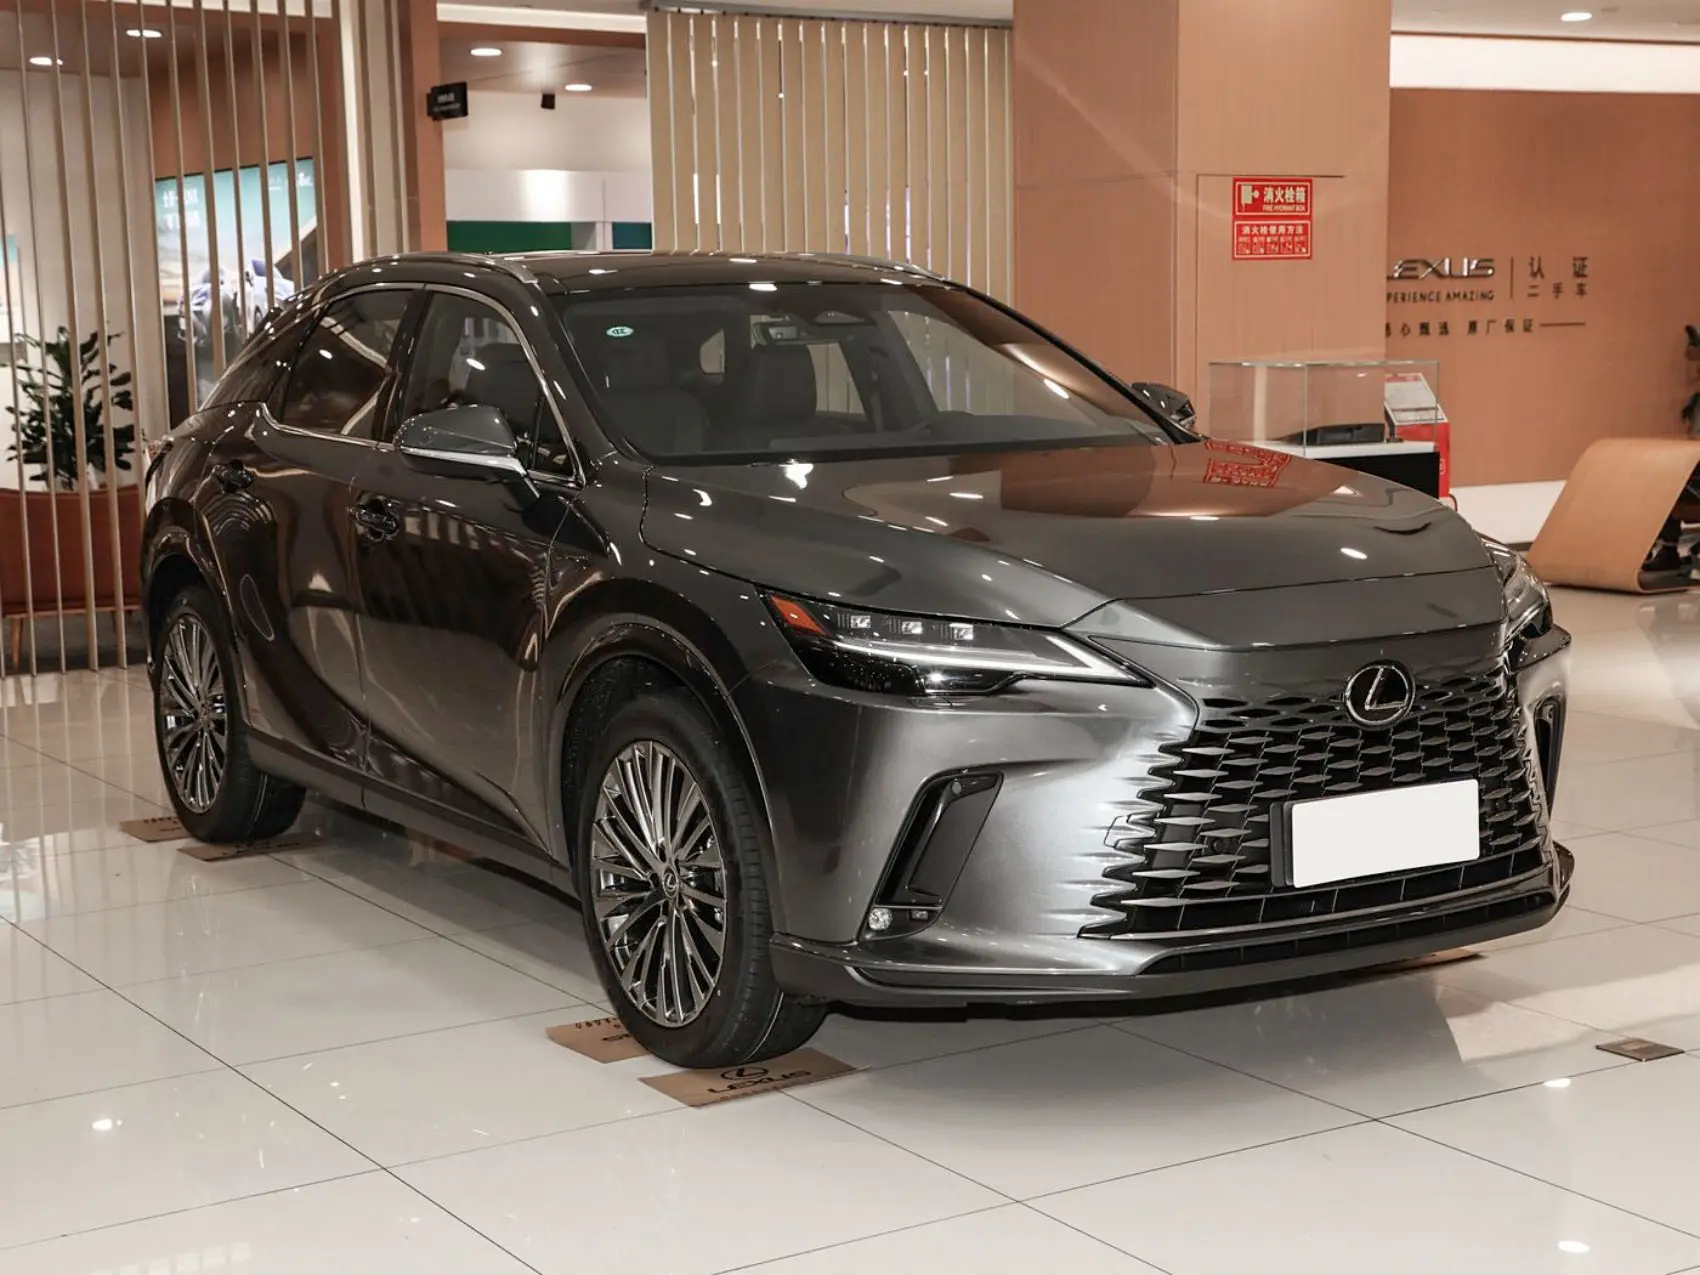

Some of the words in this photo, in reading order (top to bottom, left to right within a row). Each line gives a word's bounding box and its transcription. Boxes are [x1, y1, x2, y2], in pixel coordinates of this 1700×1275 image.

[1263, 186, 1306, 203] 消火栓箱
[1528, 256, 1588, 279] 认证
[1446, 290, 1495, 301] AMAZING
[1527, 282, 1588, 298] 二手车
[707, 1069, 812, 1094] LEXUS
